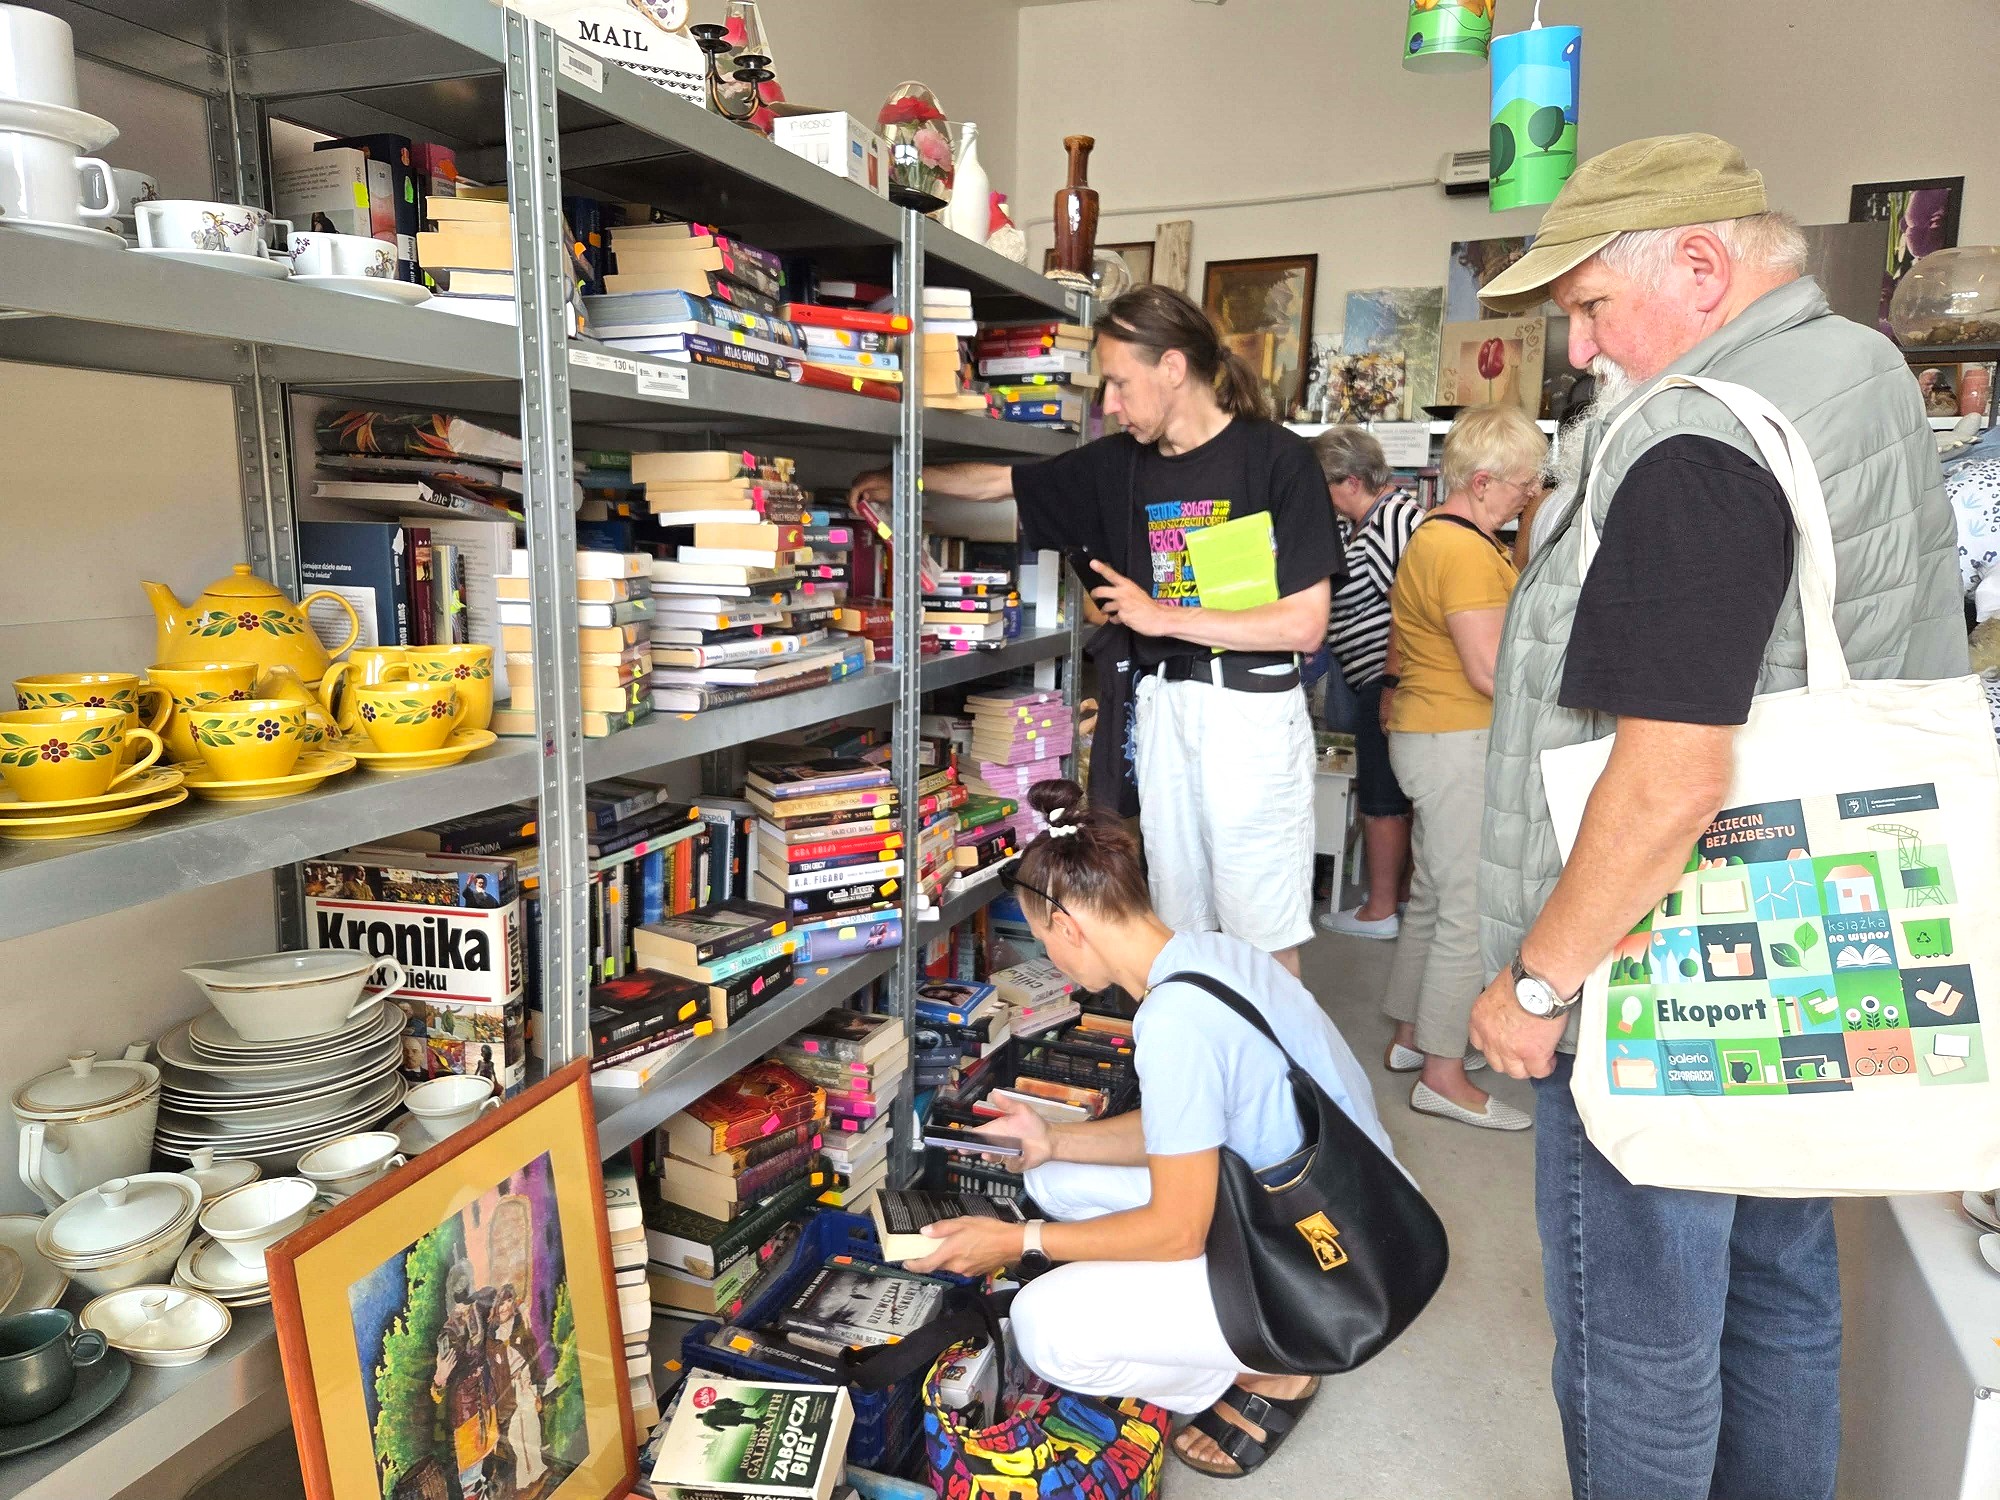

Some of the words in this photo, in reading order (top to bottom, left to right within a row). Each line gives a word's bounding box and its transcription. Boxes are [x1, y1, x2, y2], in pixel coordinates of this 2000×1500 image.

[578, 20, 648, 51] MAIL
[613, 359, 627, 371] 130
[742, 348, 770, 366] GWIAZD
[1705, 813, 1764, 835] SZCZECIN
[1705, 836, 1729, 849] BEZ
[1730, 824, 1797, 845] AZBESTU
[813, 872, 844, 885] FIGARO
[1827, 916, 1886, 932] książka
[1829, 934, 1845, 944] na
[1848, 930, 1890, 944] wynos
[316, 910, 491, 972] Kronika
[507, 910, 521, 993] Kronika
[1657, 998, 1767, 1028] Ekoport
[1668, 1052, 1709, 1066] galeria
[866, 1281, 902, 1325] DZIEWCZYNA
[740, 1427, 760, 1469] ROBERT
[747, 1393, 785, 1479] GALBRAITH
[771, 1395, 811, 1482] ZABÓJCZA
[790, 1431, 818, 1477] BIEL
